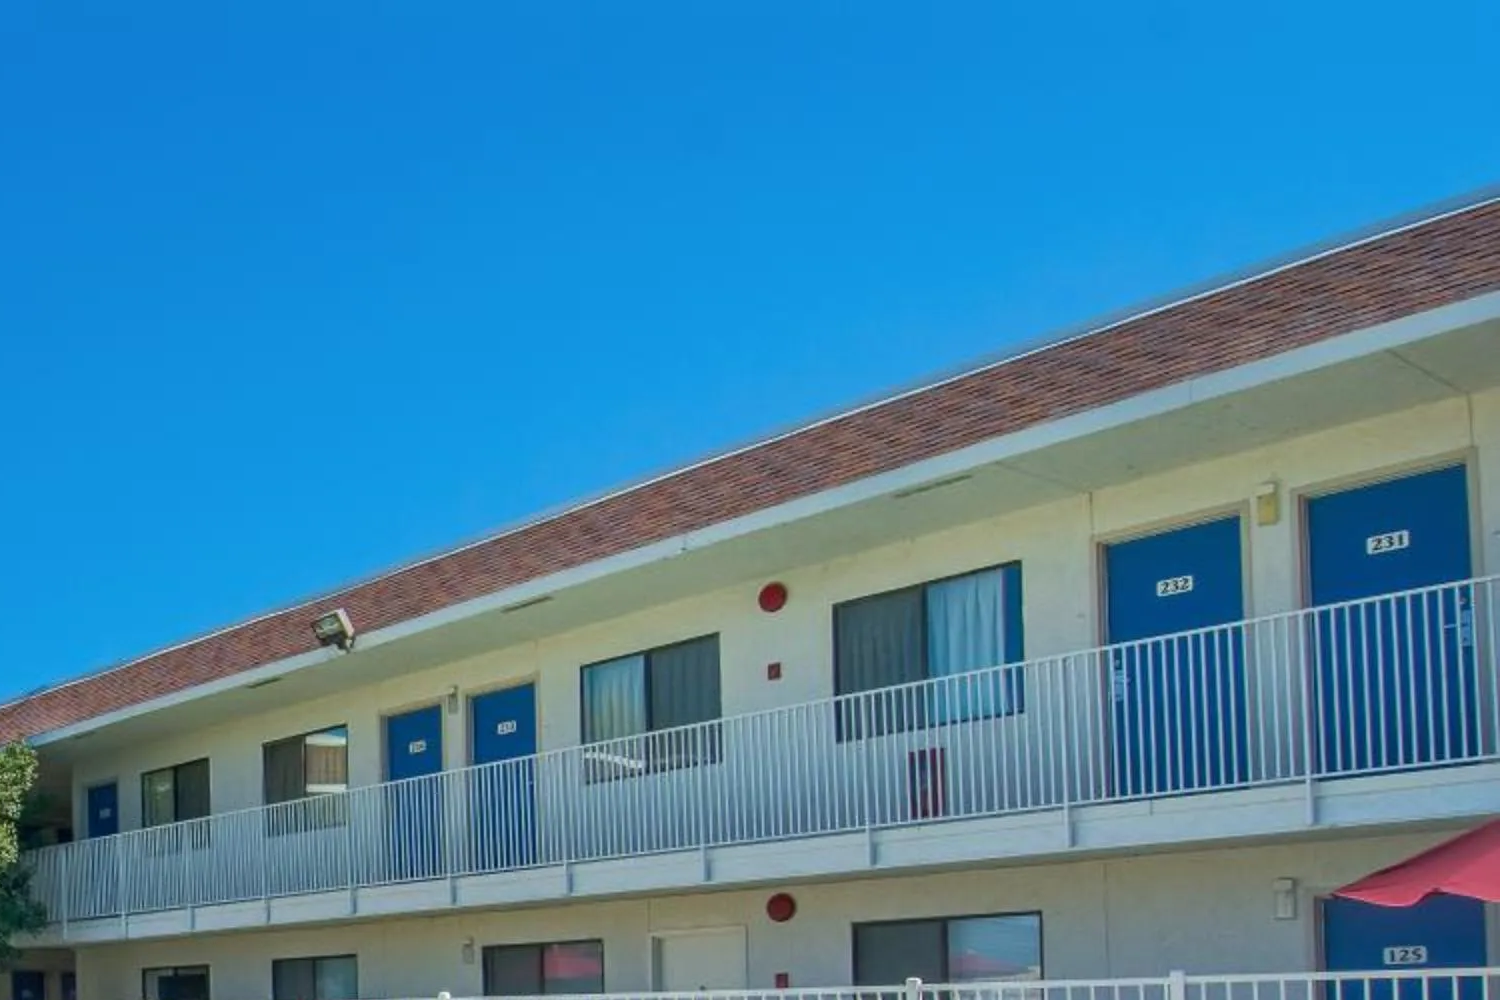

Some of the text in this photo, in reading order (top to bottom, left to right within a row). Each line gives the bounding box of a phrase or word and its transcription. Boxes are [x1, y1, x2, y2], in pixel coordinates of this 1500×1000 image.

[1371, 533, 1405, 551] 231
[1160, 577, 1191, 595] 232
[1389, 947, 1423, 962] 125
